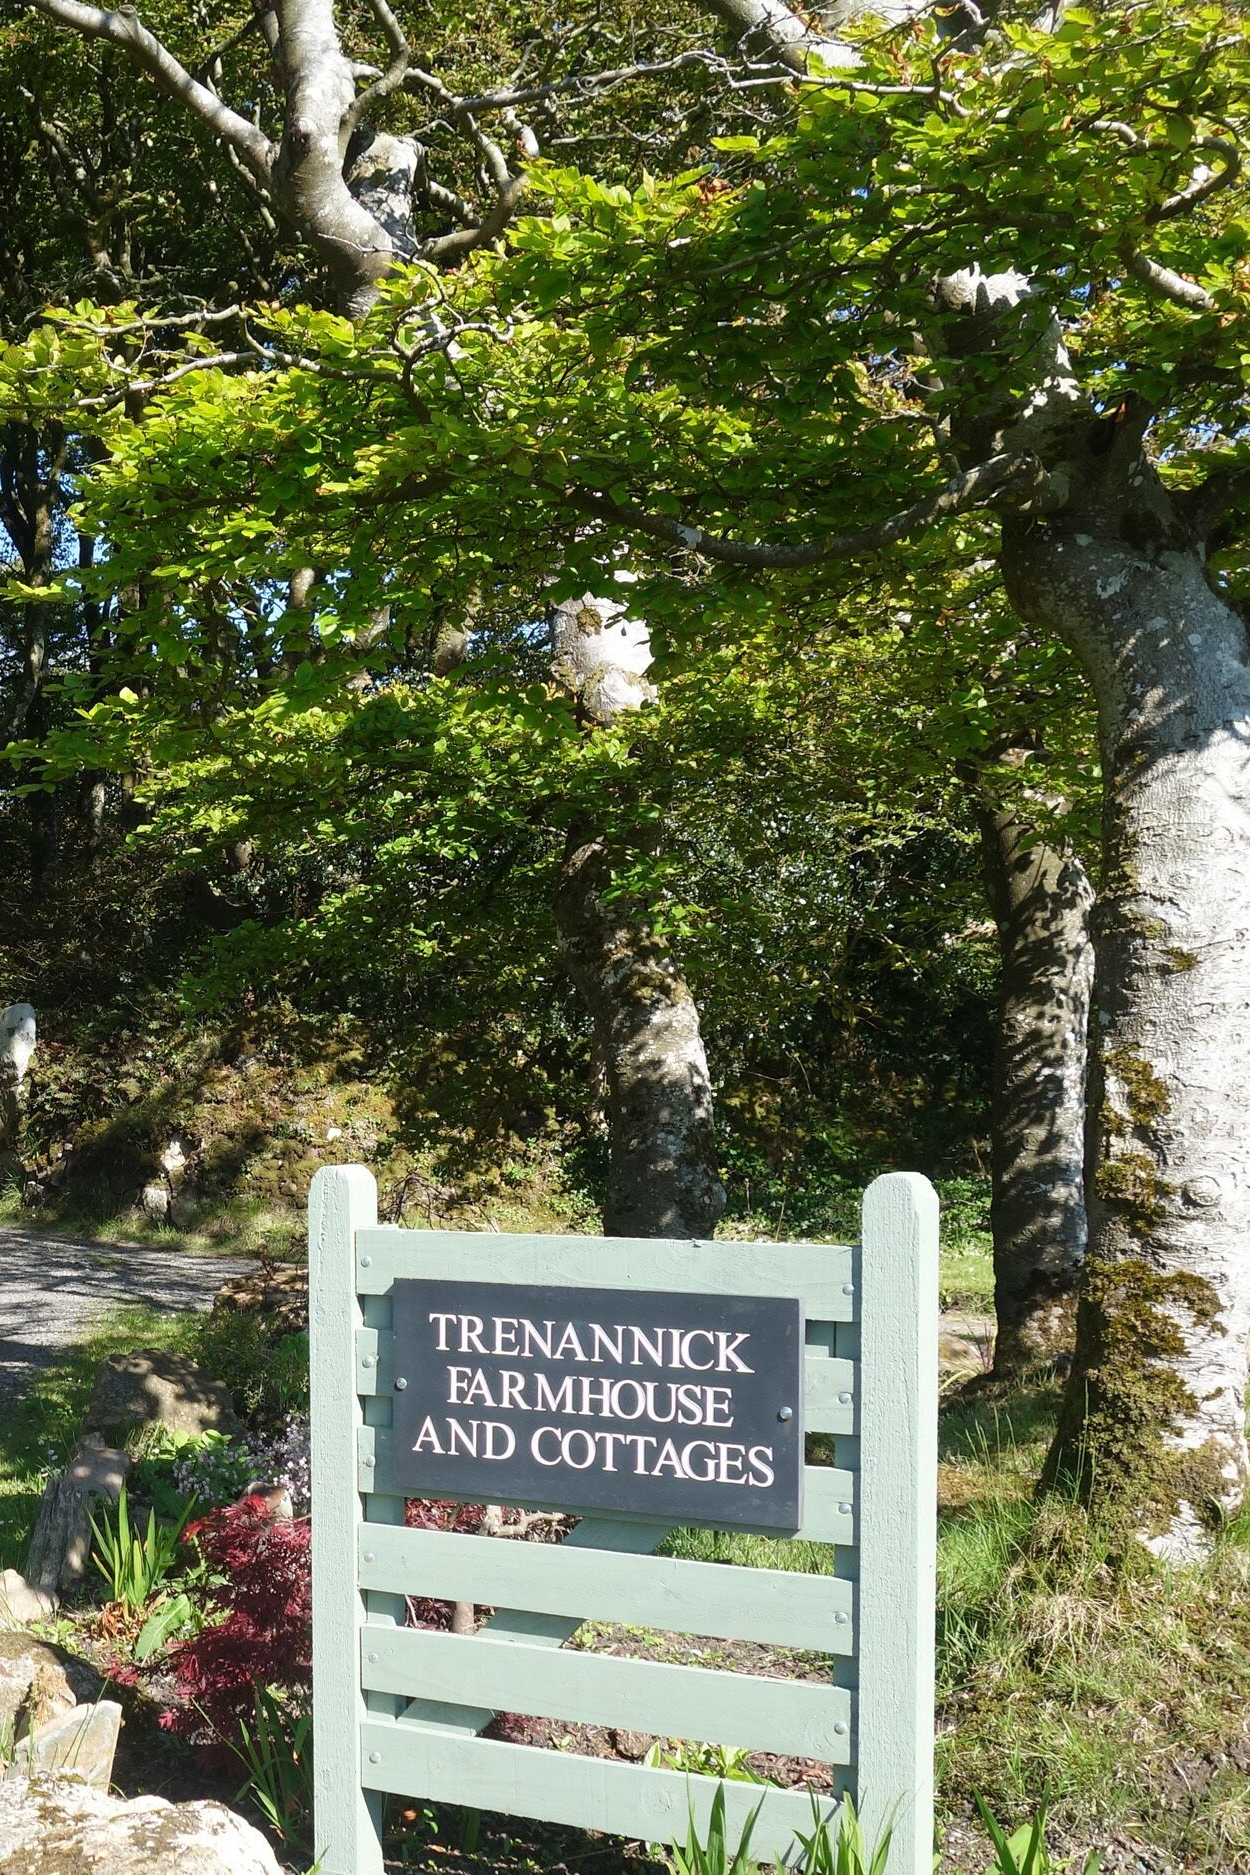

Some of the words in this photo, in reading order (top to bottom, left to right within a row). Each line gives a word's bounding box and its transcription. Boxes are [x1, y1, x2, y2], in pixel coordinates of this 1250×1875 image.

[429, 1313, 755, 1373] TRENANNICK
[447, 1366, 734, 1427] FARMHOUSE
[412, 1416, 516, 1459] AND
[530, 1427, 775, 1487] COTTAGES
